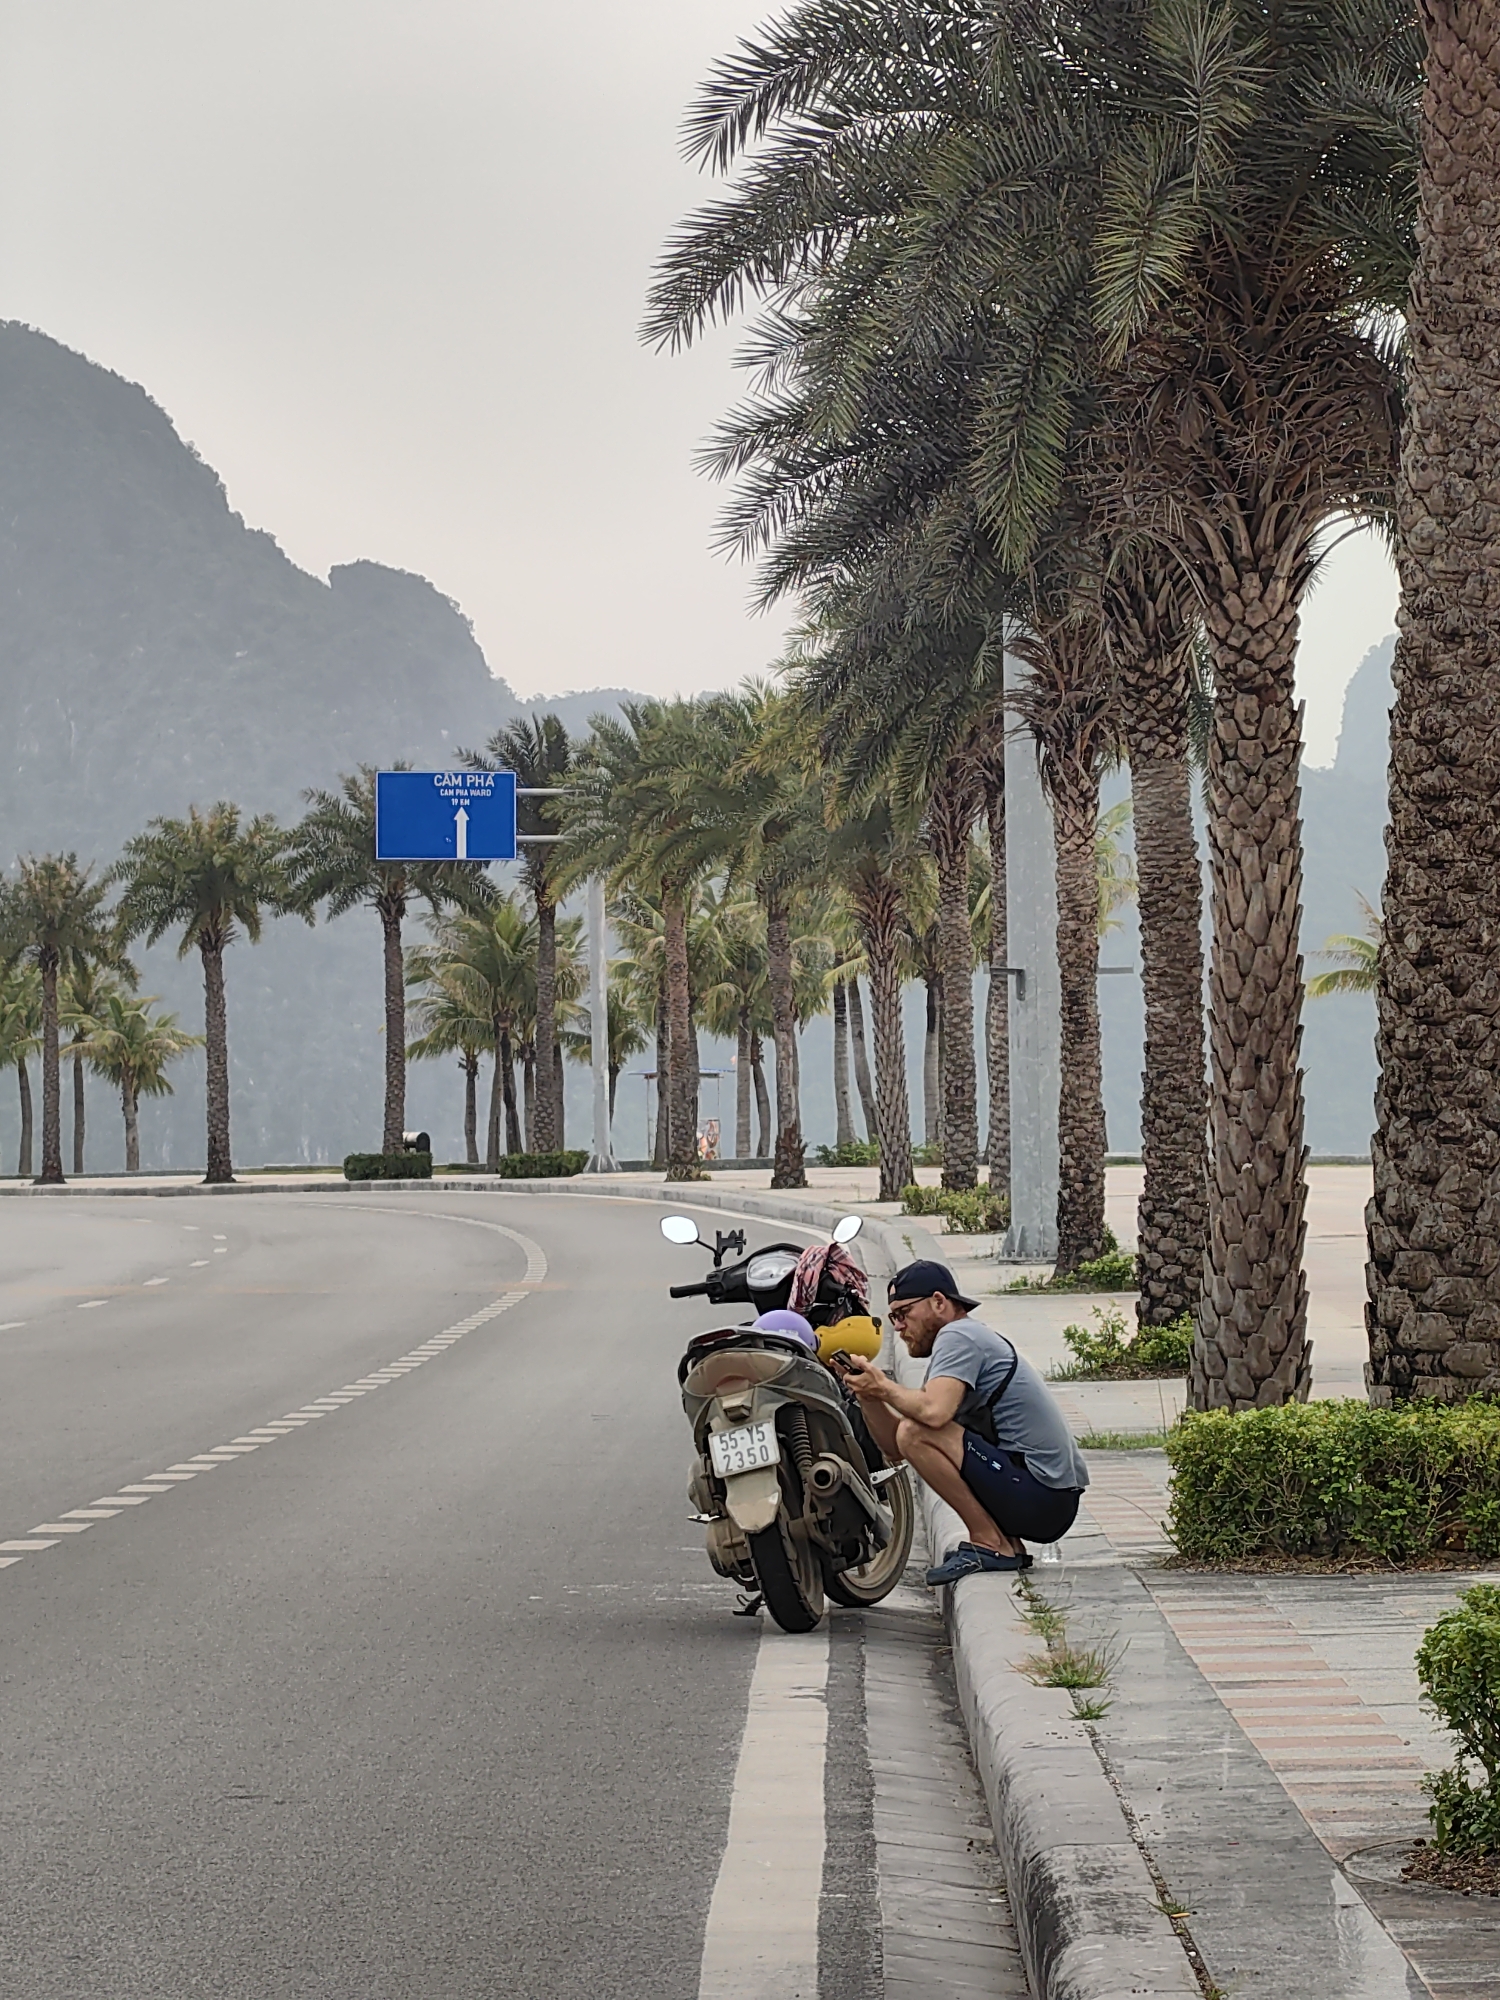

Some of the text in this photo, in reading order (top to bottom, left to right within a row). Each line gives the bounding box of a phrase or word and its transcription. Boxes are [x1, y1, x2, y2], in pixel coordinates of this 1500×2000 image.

[440, 789, 492, 797] CAM PHA WARD
[451, 798, 470, 806] 19 KM
[718, 1422, 766, 1452] 55-Y5
[723, 1444, 770, 1473] 2350
